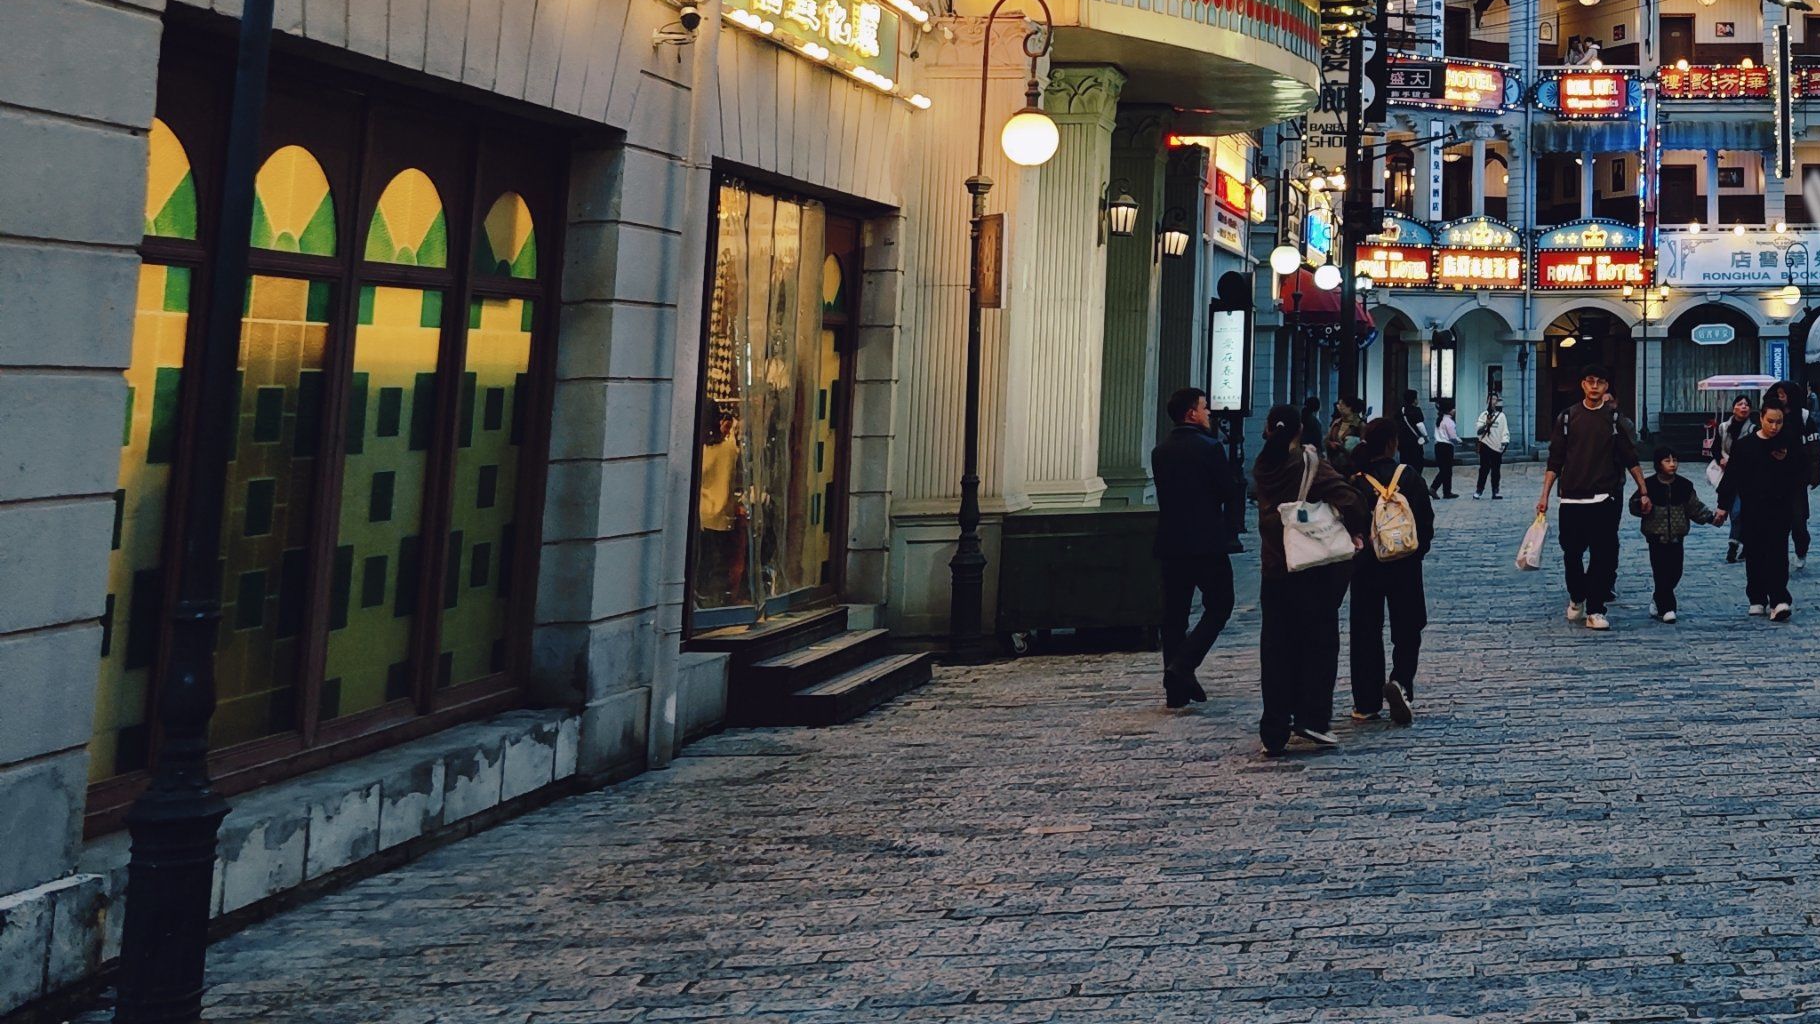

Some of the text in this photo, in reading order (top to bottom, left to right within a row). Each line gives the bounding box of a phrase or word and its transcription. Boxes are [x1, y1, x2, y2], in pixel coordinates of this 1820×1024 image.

[1547, 263, 1644, 282] ROYAL HOTEL
[1702, 272, 1771, 281] RONGHUA
